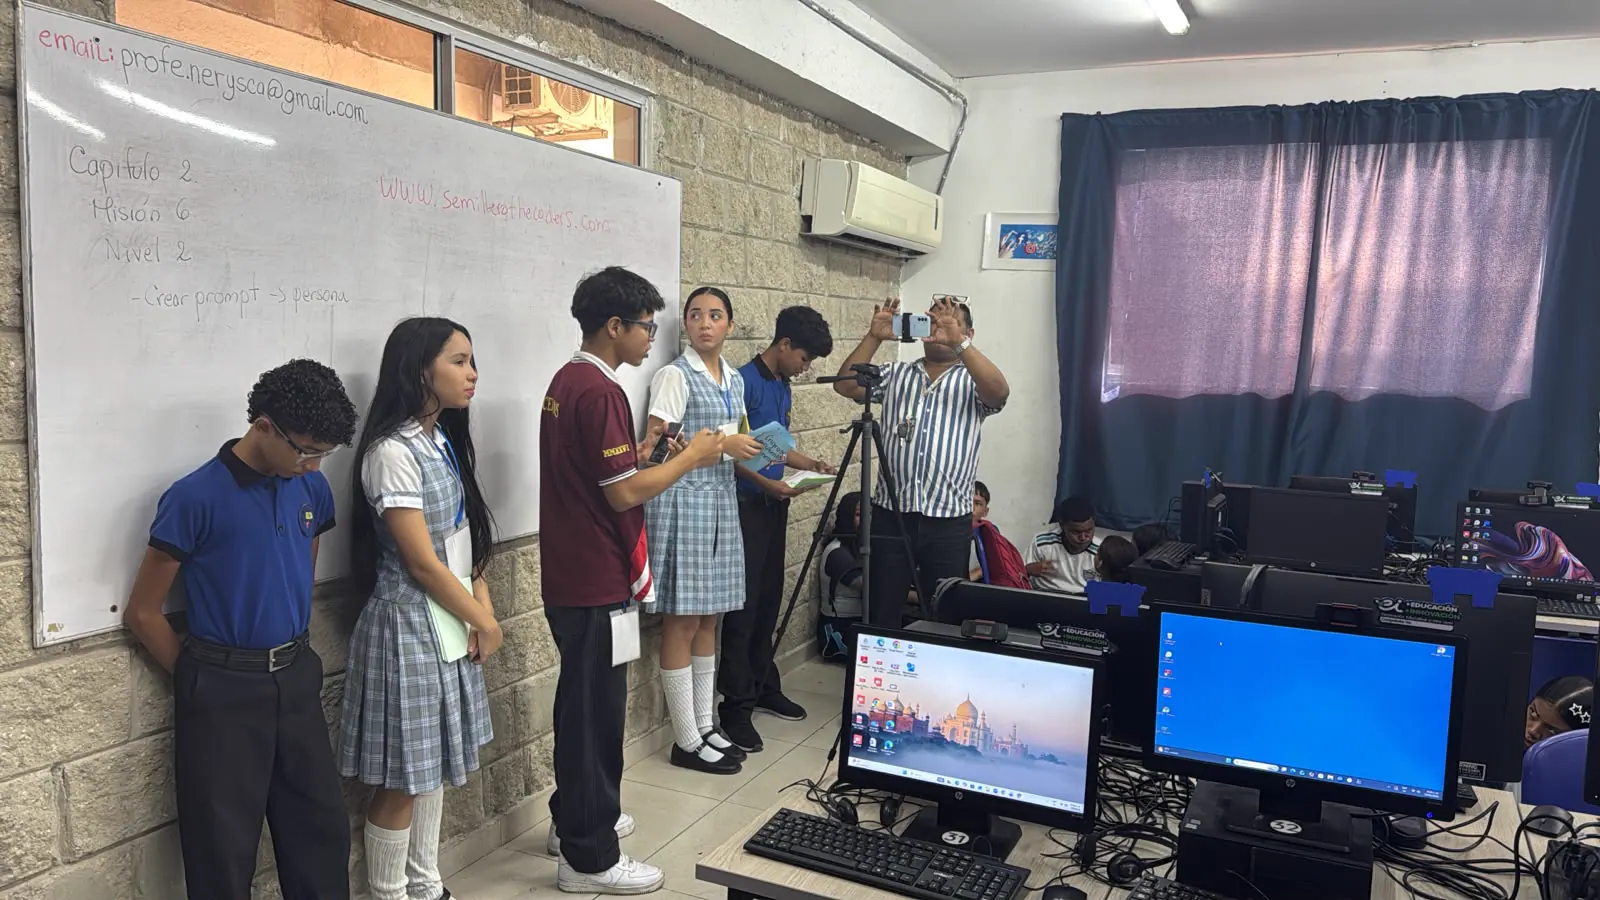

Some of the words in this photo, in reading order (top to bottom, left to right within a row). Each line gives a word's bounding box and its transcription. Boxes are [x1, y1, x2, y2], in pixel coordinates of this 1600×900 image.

[38, 29, 114, 63] email:
[121, 44, 369, 125] profe.nerysca@gmail.com
[92, 195, 161, 224] Misión
[175, 197, 191, 221] 6
[104, 235, 160, 263] Nivel
[175, 240, 192, 262] 2
[194, 272, 260, 323] prompt
[292, 286, 349, 314] persona
